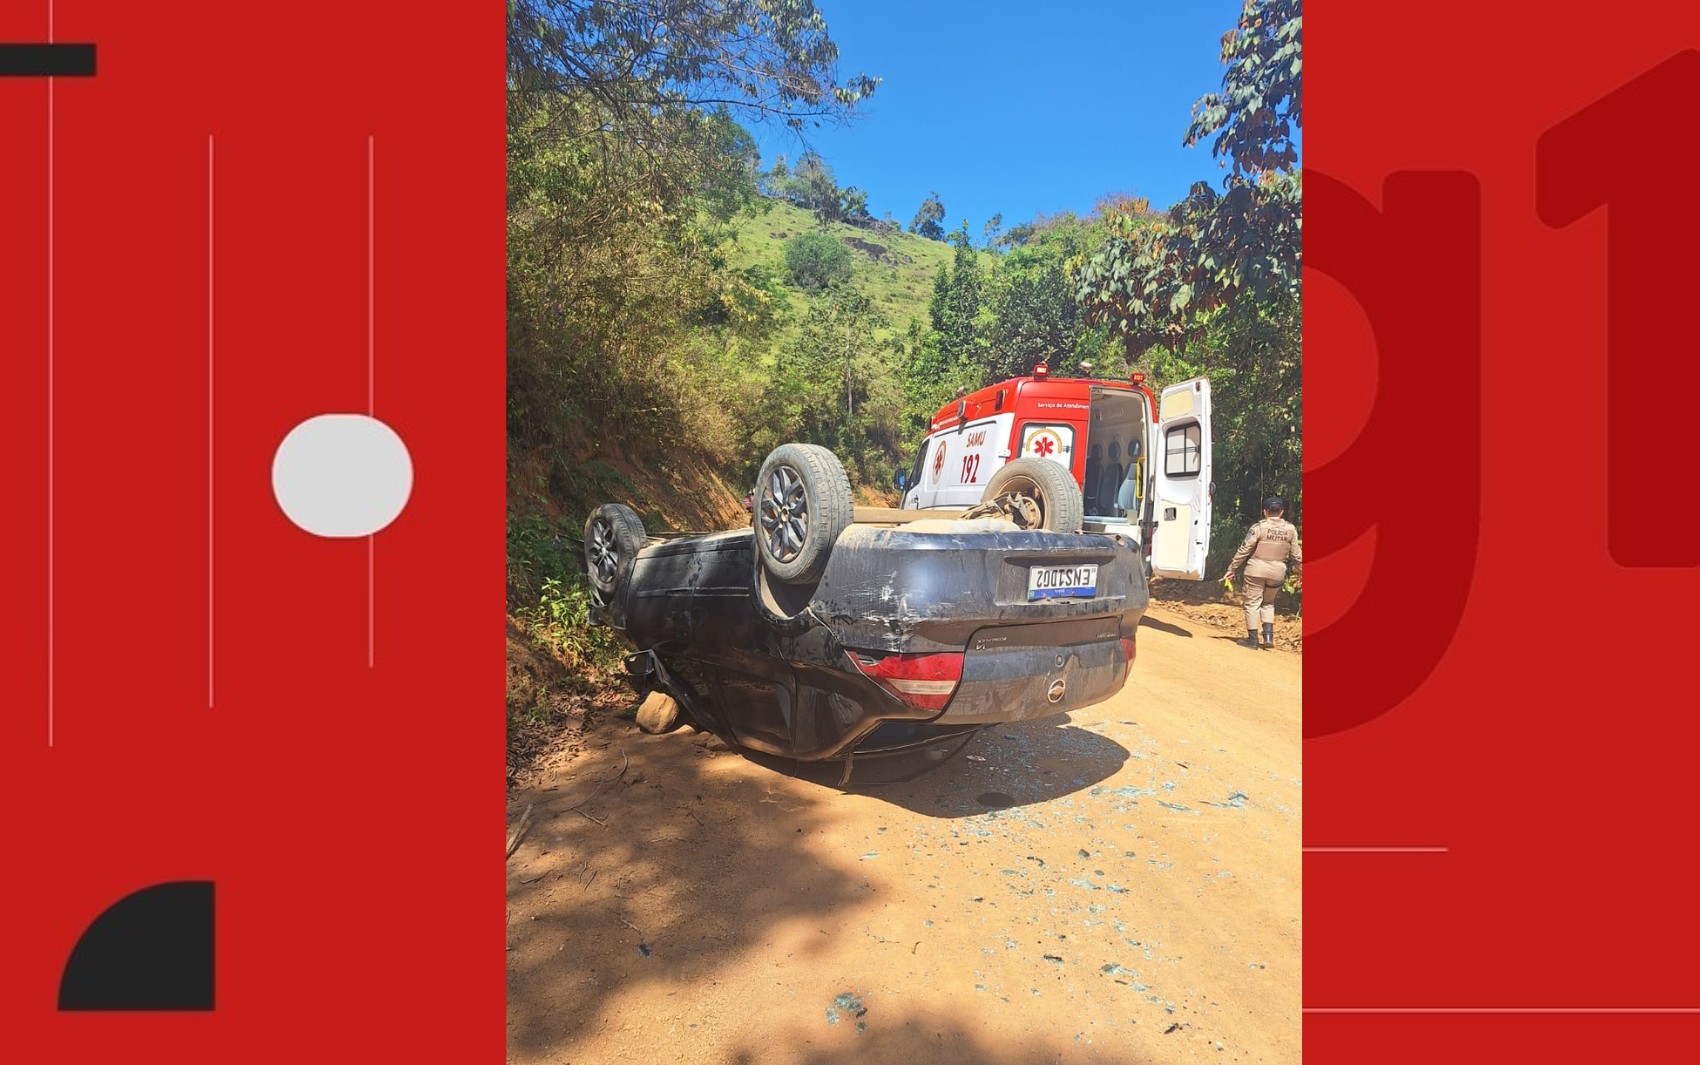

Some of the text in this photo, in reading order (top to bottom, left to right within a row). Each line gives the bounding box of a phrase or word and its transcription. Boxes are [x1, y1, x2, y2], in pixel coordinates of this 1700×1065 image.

[966, 430, 987, 448] SAMU
[960, 453, 980, 484] 192
[1037, 569, 1090, 588] ENS1D02
